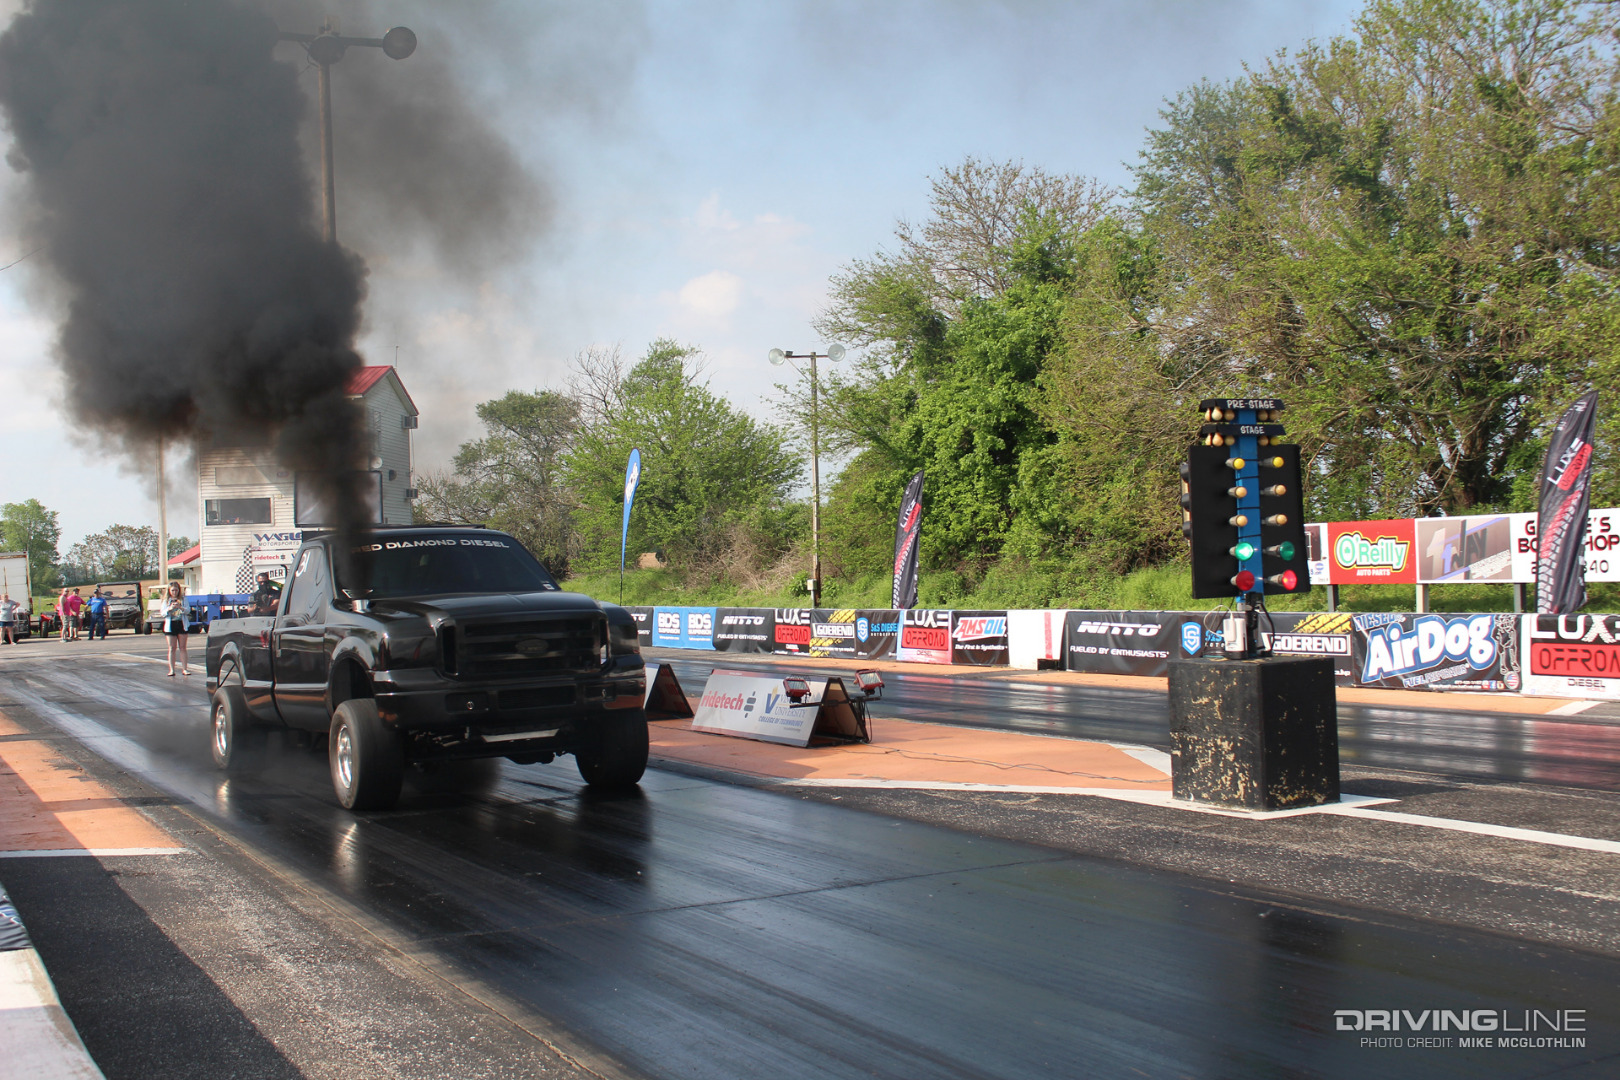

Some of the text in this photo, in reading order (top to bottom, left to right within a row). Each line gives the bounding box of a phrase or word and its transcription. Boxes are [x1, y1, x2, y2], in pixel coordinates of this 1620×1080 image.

[1227, 399, 1275, 409] PRE-STAGE
[1240, 426, 1265, 435] STAGE
[385, 540, 457, 550] DIAMOND
[459, 539, 510, 548] DIESEL
[1338, 534, 1405, 567] O'Reilly
[1584, 534, 1620, 551] HOP
[657, 612, 680, 628] BDS
[688, 613, 712, 629] BDS
[722, 615, 765, 625] NITTO
[774, 609, 811, 625] LUXE
[903, 610, 950, 628] LUXE
[777, 626, 809, 643] OFFROAD
[816, 625, 853, 636] GOEREND
[955, 618, 1005, 639] AMSOIL
[1076, 620, 1162, 636] NITTO
[905, 631, 946, 647] OFFROAD
[1270, 635, 1347, 652] GOEREND
[1367, 615, 1494, 677] AirDog
[1069, 646, 1097, 654] FUELED
[1098, 647, 1110, 655] BY
[1567, 678, 1606, 688] DIESEL
[701, 691, 744, 710] ridetech
